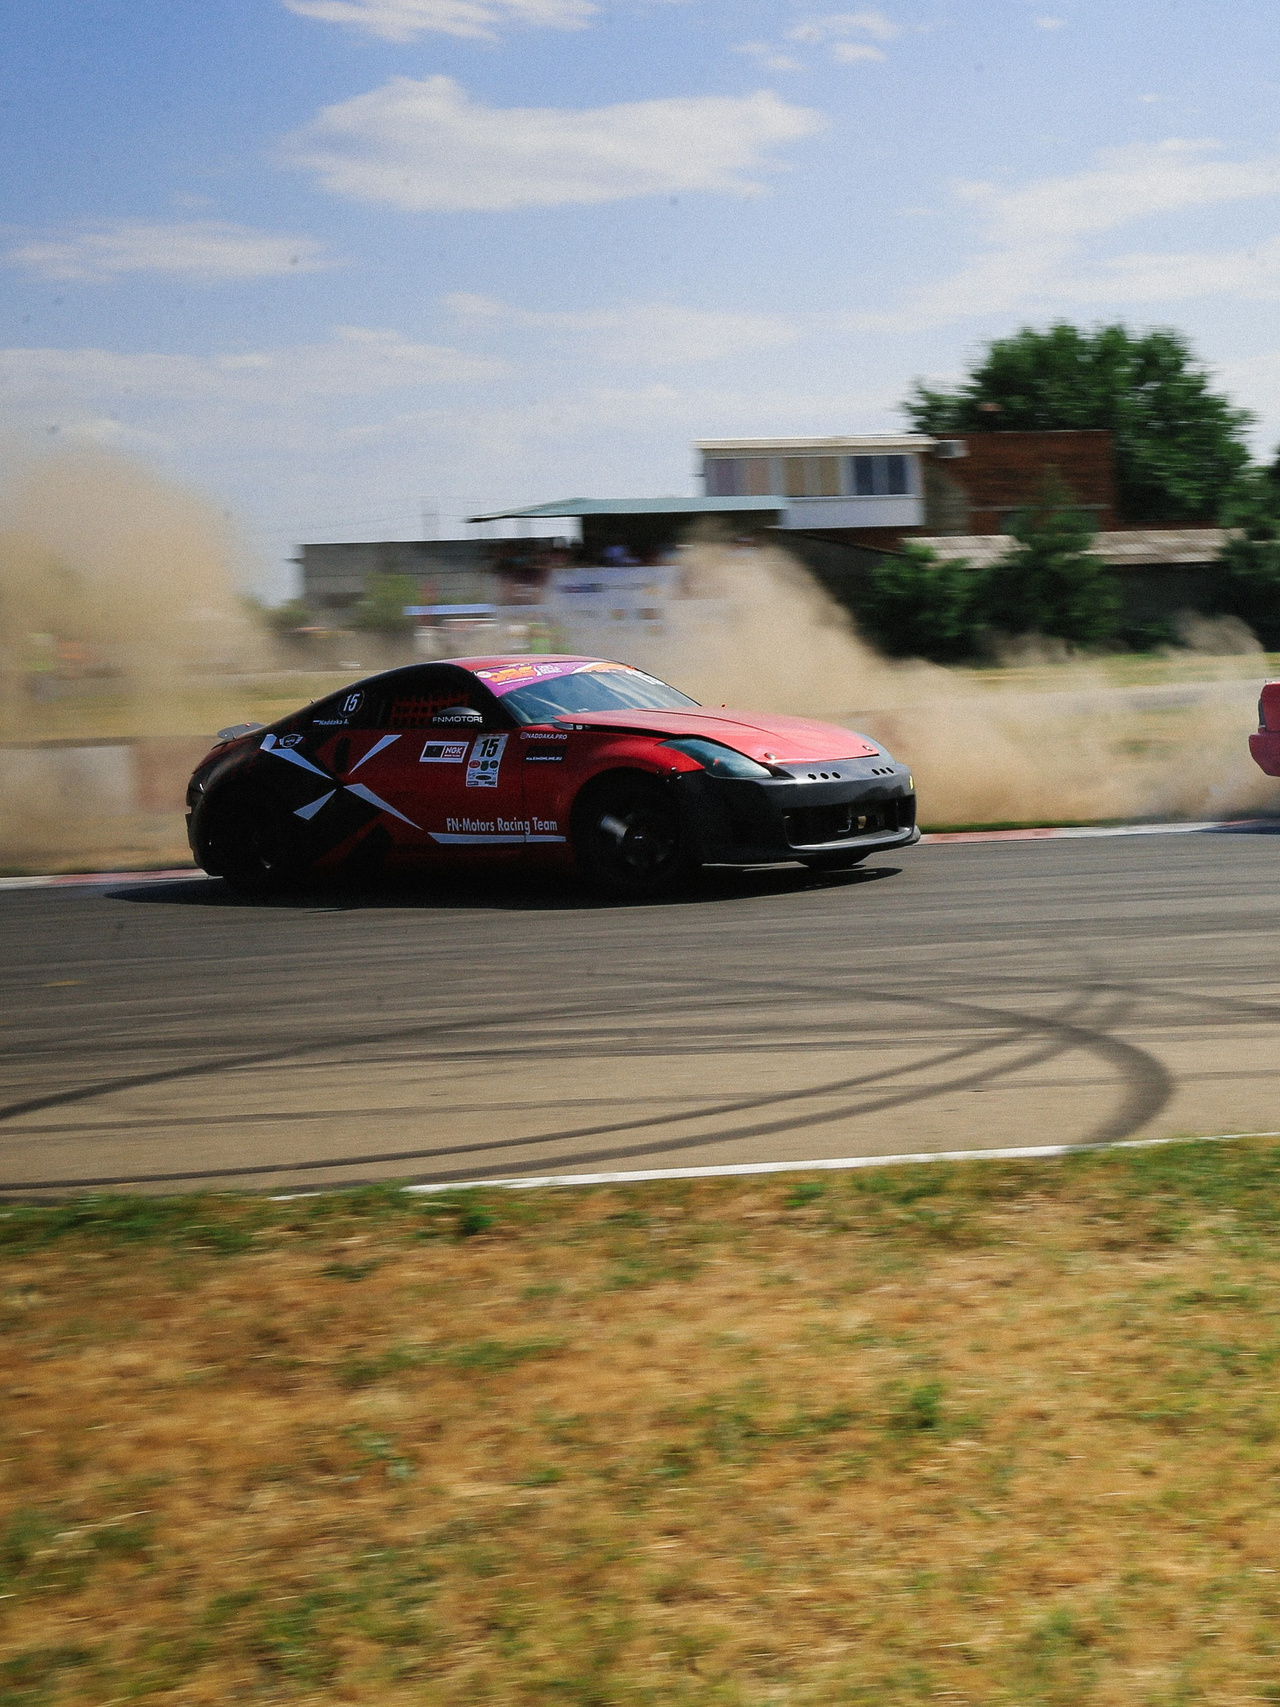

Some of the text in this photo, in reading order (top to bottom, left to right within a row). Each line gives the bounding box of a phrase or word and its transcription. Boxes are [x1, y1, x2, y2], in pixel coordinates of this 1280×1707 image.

[342, 694, 361, 712] 15
[479, 738, 500, 758] 15
[497, 817, 531, 835] Racing
[532, 817, 558, 831] Team
